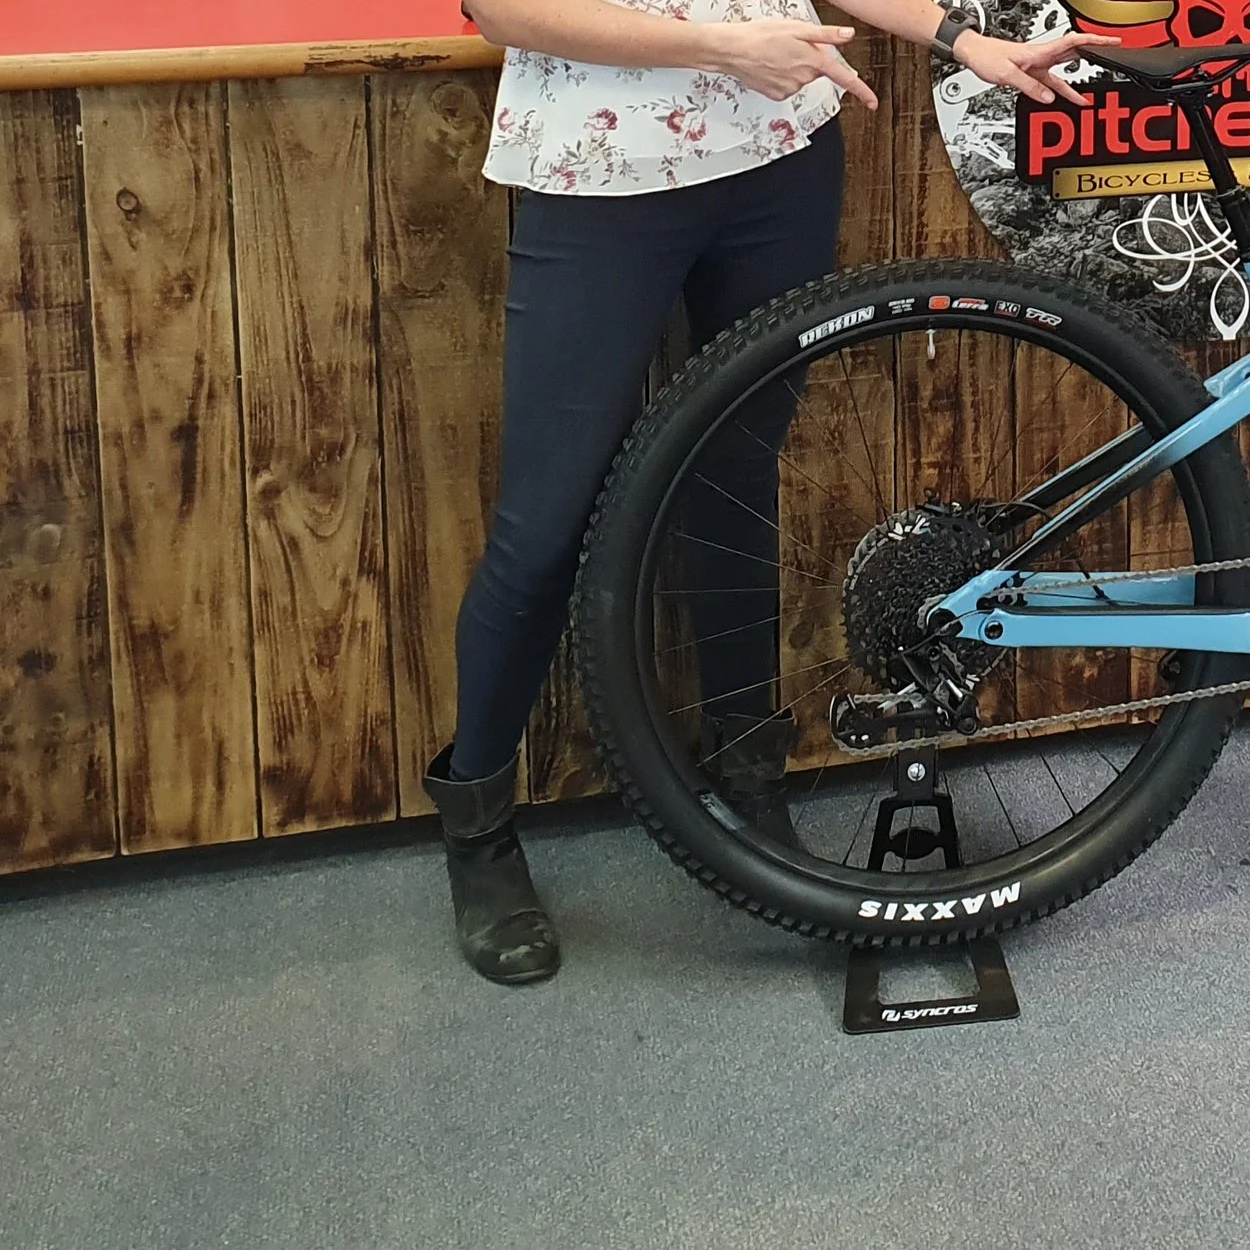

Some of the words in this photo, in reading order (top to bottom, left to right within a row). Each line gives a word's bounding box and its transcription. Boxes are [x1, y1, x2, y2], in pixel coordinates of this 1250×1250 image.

[1077, 169, 1212, 193] BICYCLES
[998, 301, 1019, 314] EXO
[858, 881, 1021, 921] MAXXIS
[901, 1003, 979, 1019] syncros
